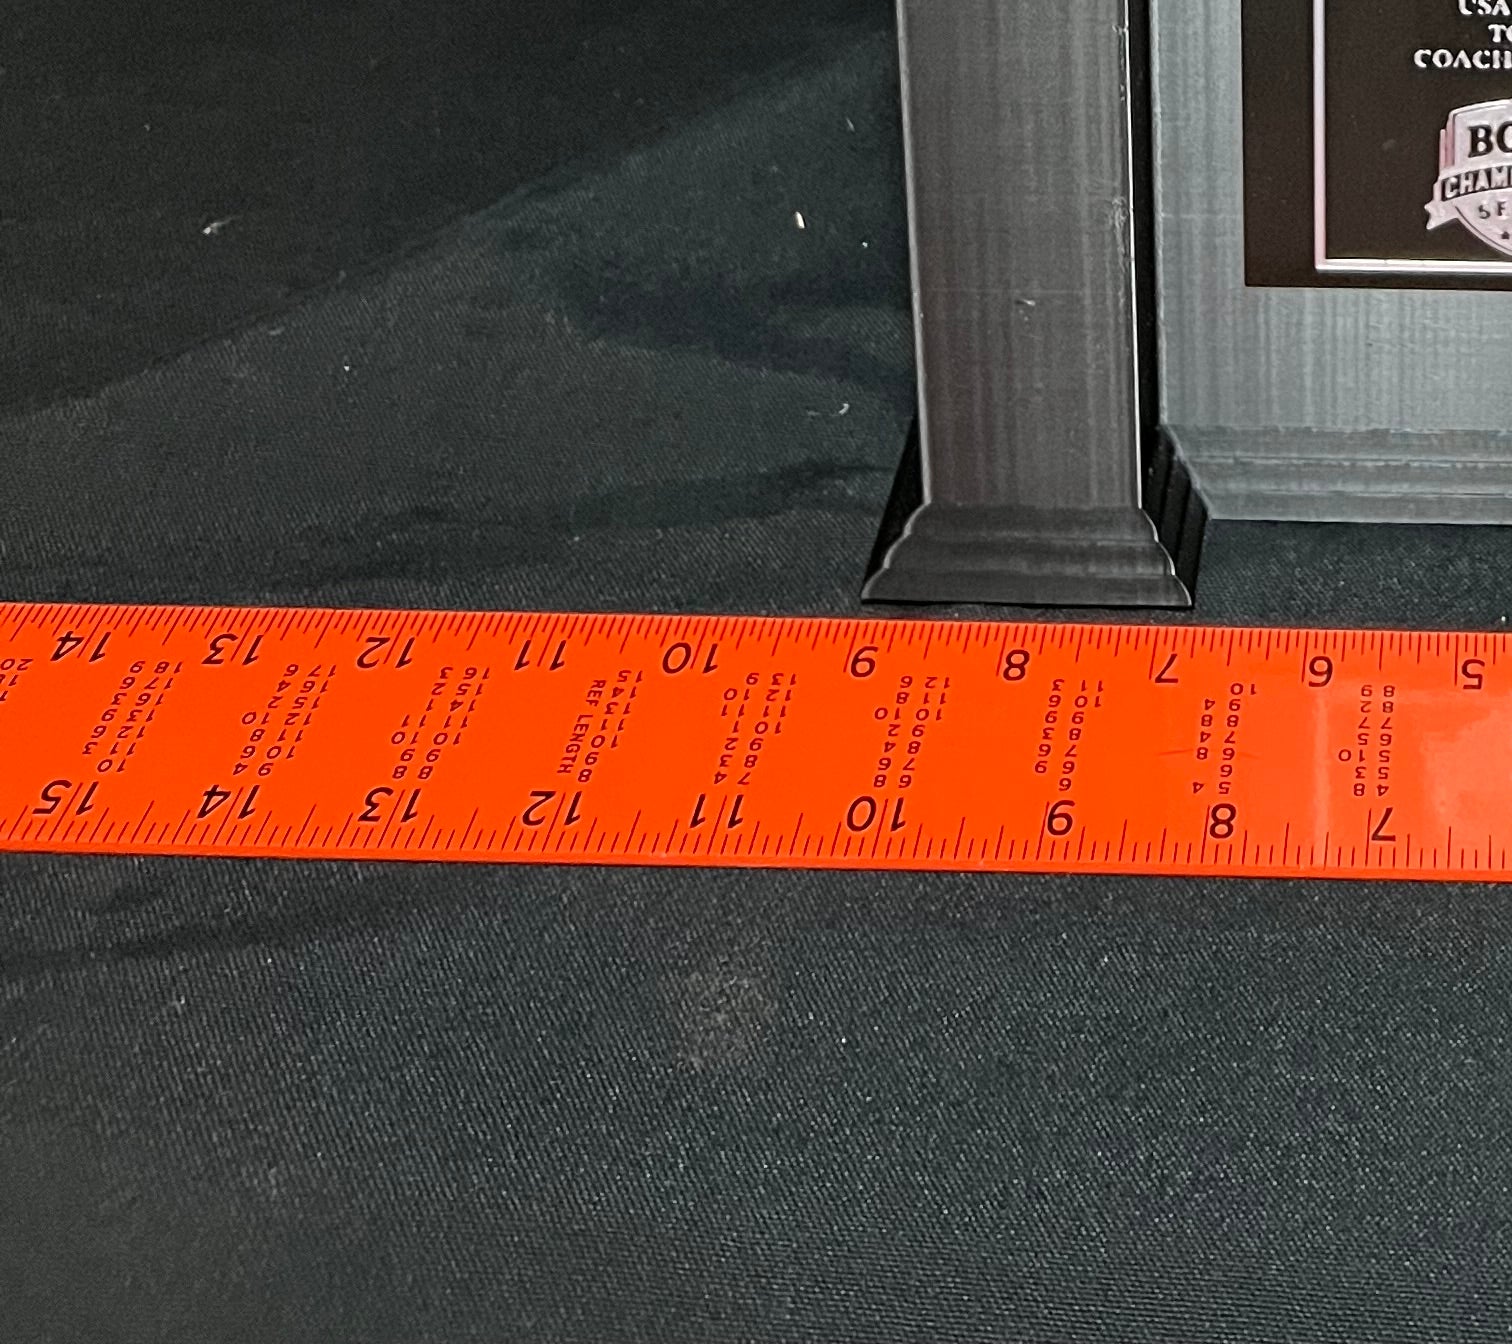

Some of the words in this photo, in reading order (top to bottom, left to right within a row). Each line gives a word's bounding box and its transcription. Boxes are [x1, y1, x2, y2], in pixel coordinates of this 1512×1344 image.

[50, 631, 111, 662] 14
[201, 634, 264, 665] 13
[357, 637, 415, 668] 12
[514, 640, 566, 670] 11
[662, 642, 718, 674] 10
[851, 646, 878, 677] 9
[1003, 650, 1030, 681] 8
[1155, 654, 1178, 683] 7
[1309, 656, 1333, 687] 6
[1462, 659, 1485, 689] 5
[586, 679, 607, 707] REF
[556, 714, 593, 774] LENGTH
[32, 780, 99, 815] 15
[197, 785, 260, 819] 14
[358, 787, 421, 822] 13
[522, 791, 582, 826] 12
[690, 794, 743, 828] 11
[847, 796, 905, 832] 10
[1047, 800, 1075, 835] 9
[1210, 803, 1236, 839] 8
[1371, 807, 1396, 841] 7
